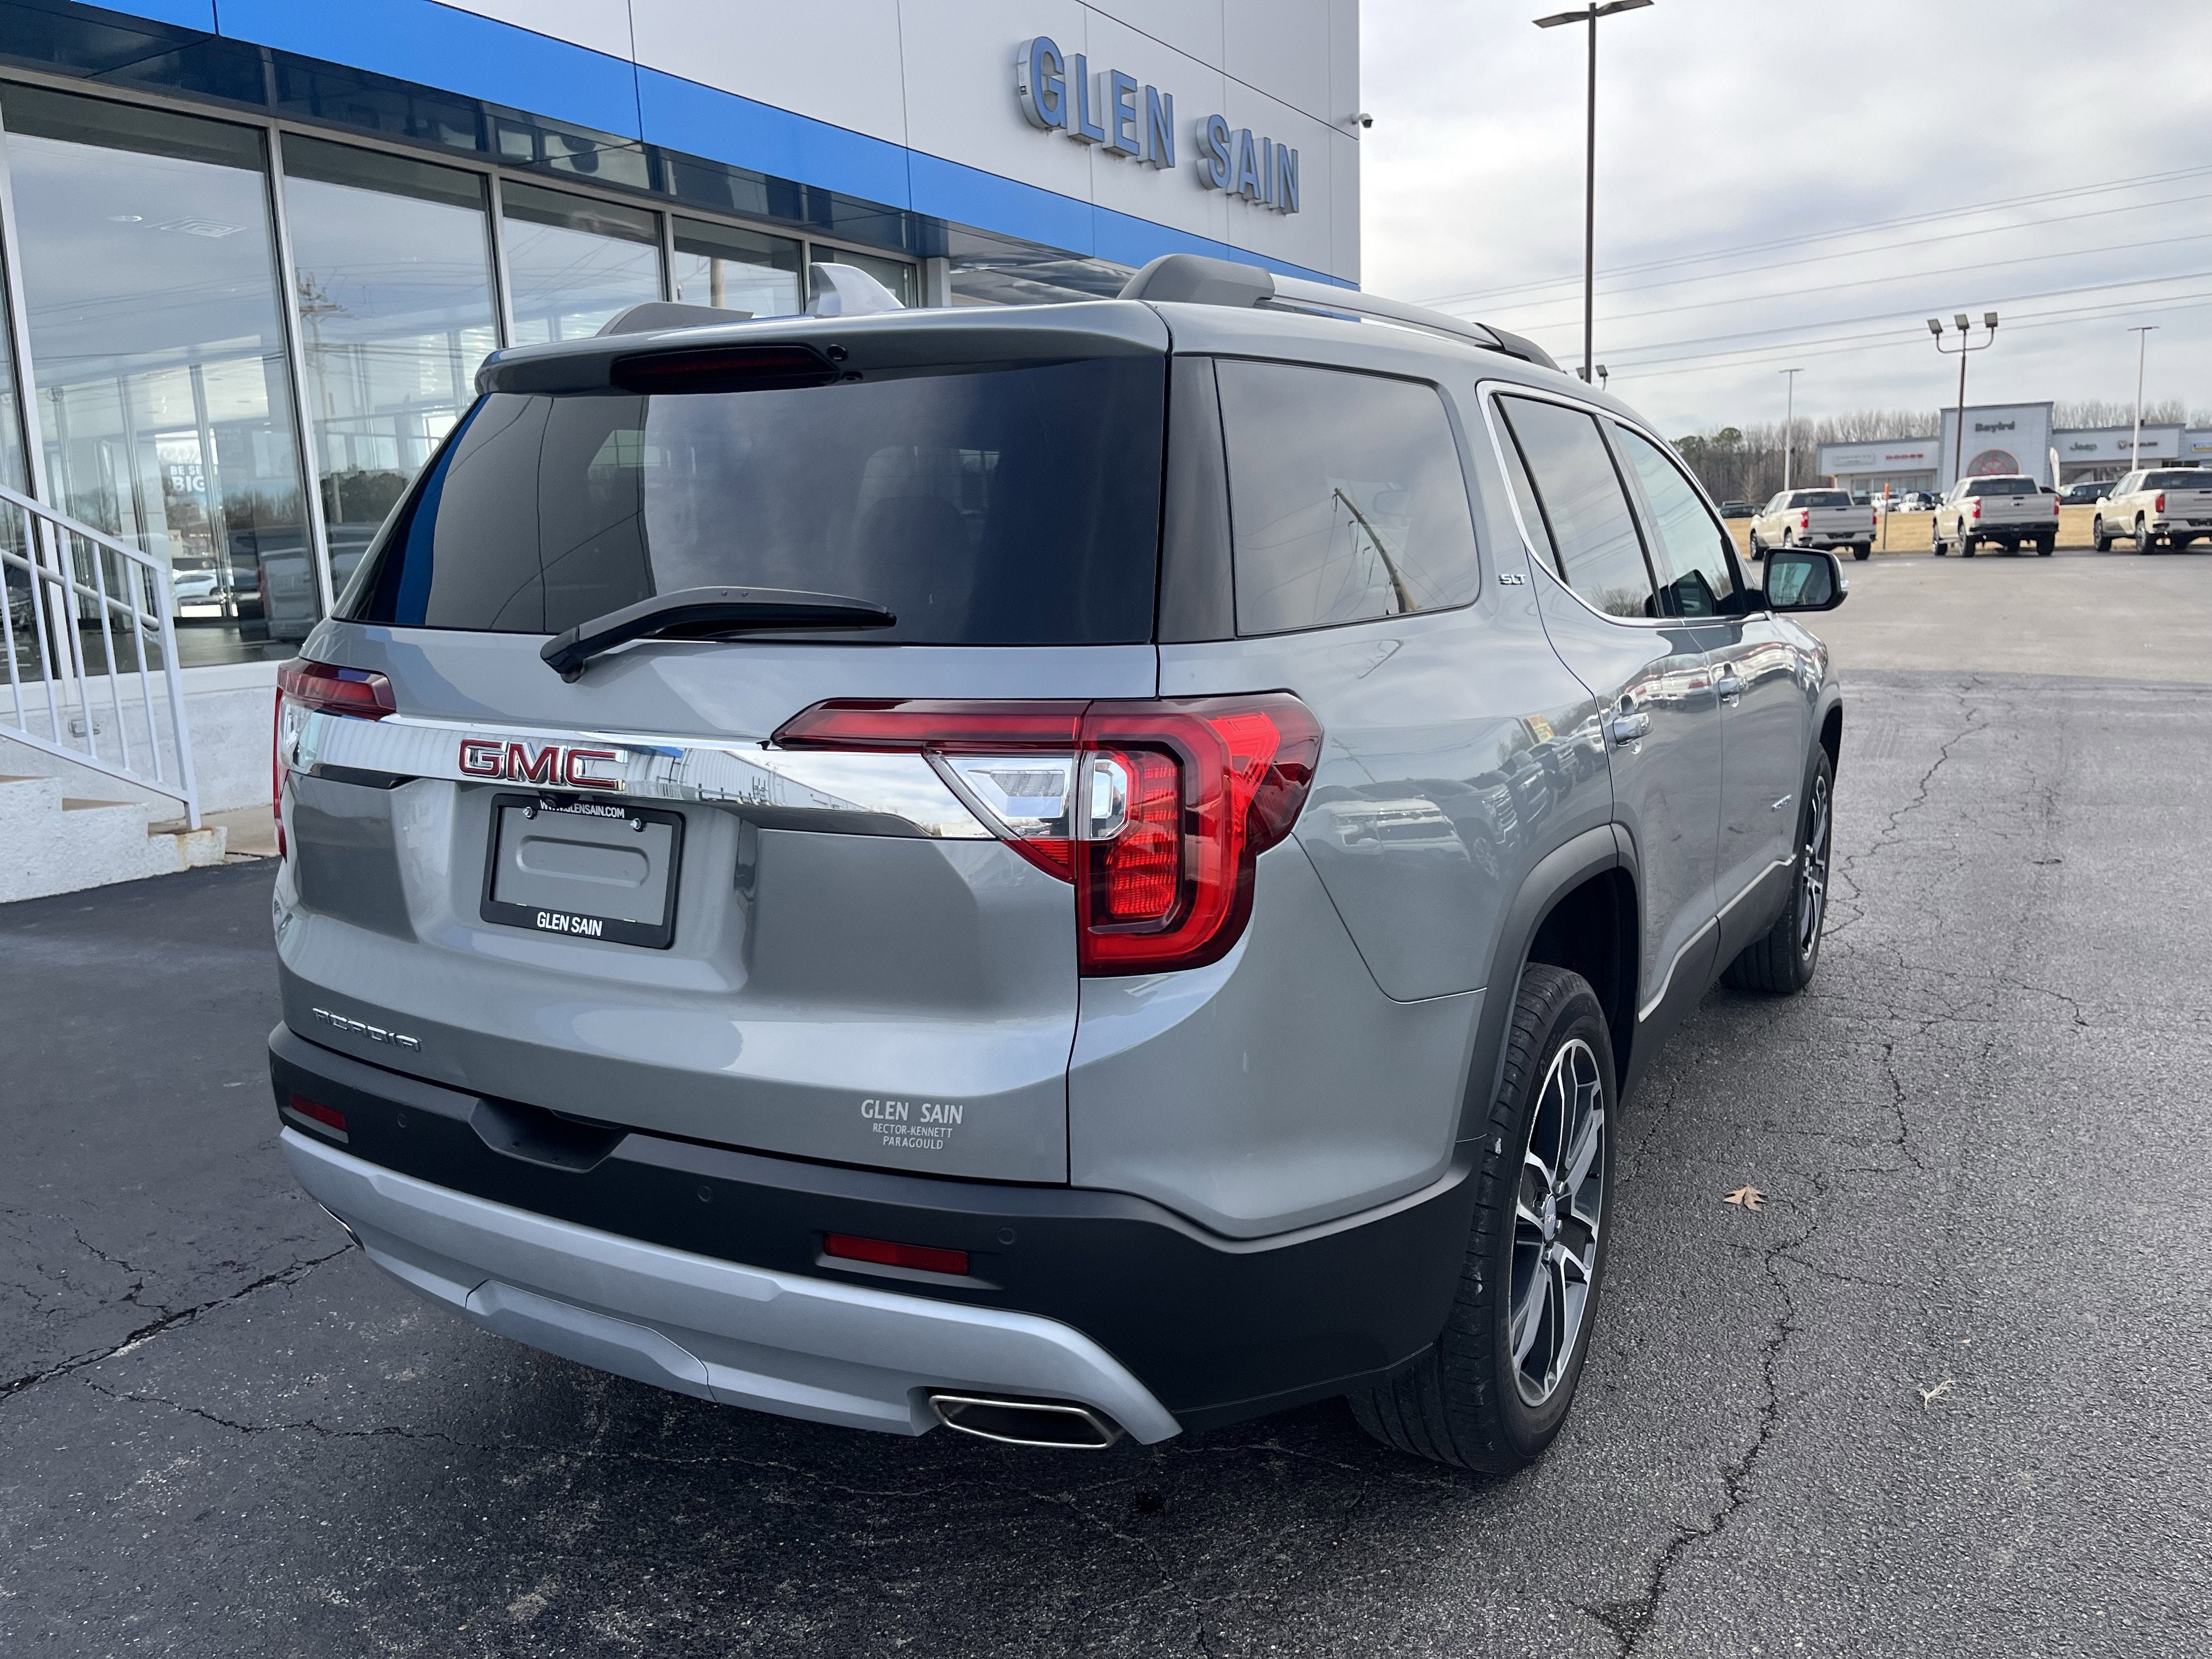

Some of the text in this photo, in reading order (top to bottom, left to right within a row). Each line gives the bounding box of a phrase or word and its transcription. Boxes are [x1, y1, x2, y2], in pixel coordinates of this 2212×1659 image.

[1030, 36, 1299, 214] GLEN SAIN
[170, 465, 185, 476] BE
[172, 475, 206, 492] BIG
[1499, 573, 1526, 585] SLT
[459, 738, 628, 791] GMC
[539, 799, 625, 819] W.LENSAIN.COM
[537, 911, 603, 936] GLEN SAIN
[861, 1099, 963, 1124] GLEN SAIN
[873, 1122, 953, 1138] RECTOR-KENNETT
[883, 1136, 944, 1149] PARAGOULD
